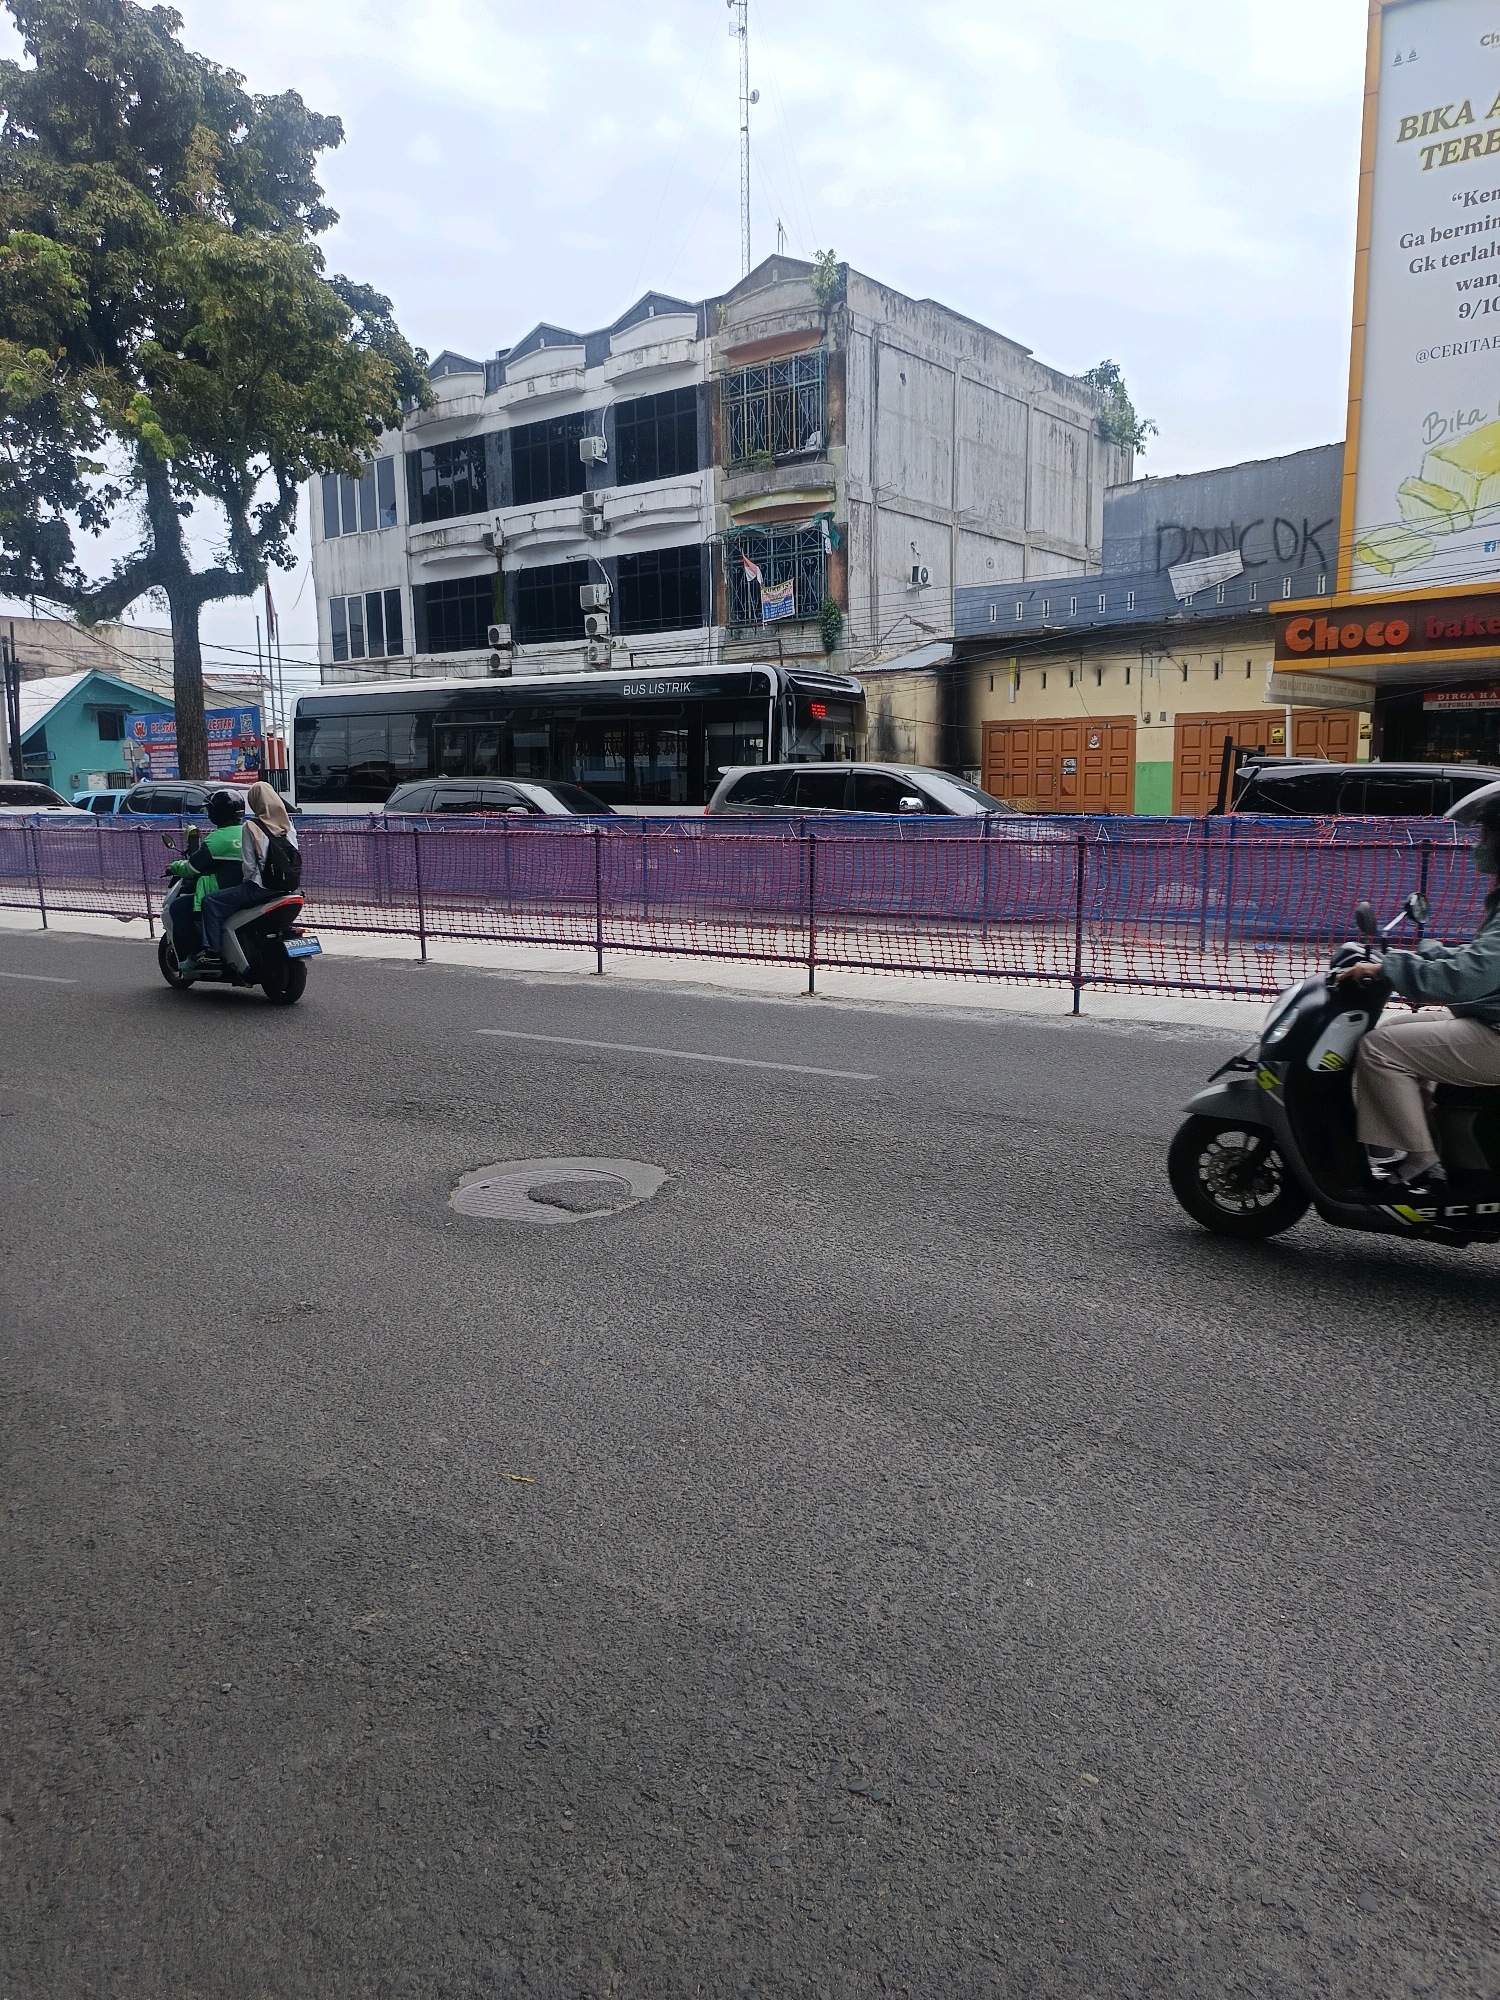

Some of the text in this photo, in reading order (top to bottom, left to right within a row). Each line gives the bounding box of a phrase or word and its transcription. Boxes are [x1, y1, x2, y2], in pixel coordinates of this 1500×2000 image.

[1396, 99, 1476, 144] BIKA
[1419, 127, 1500, 171] TERB
[1399, 232, 1425, 250] Ga
[1408, 255, 1437, 275] Gk
[1455, 272, 1500, 292] wan
[1422, 408, 1488, 446] Bika
[1285, 614, 1500, 652] Choco bake
[623, 681, 691, 696] BUS LISTRIK
[208, 717, 235, 730] LESTARI
